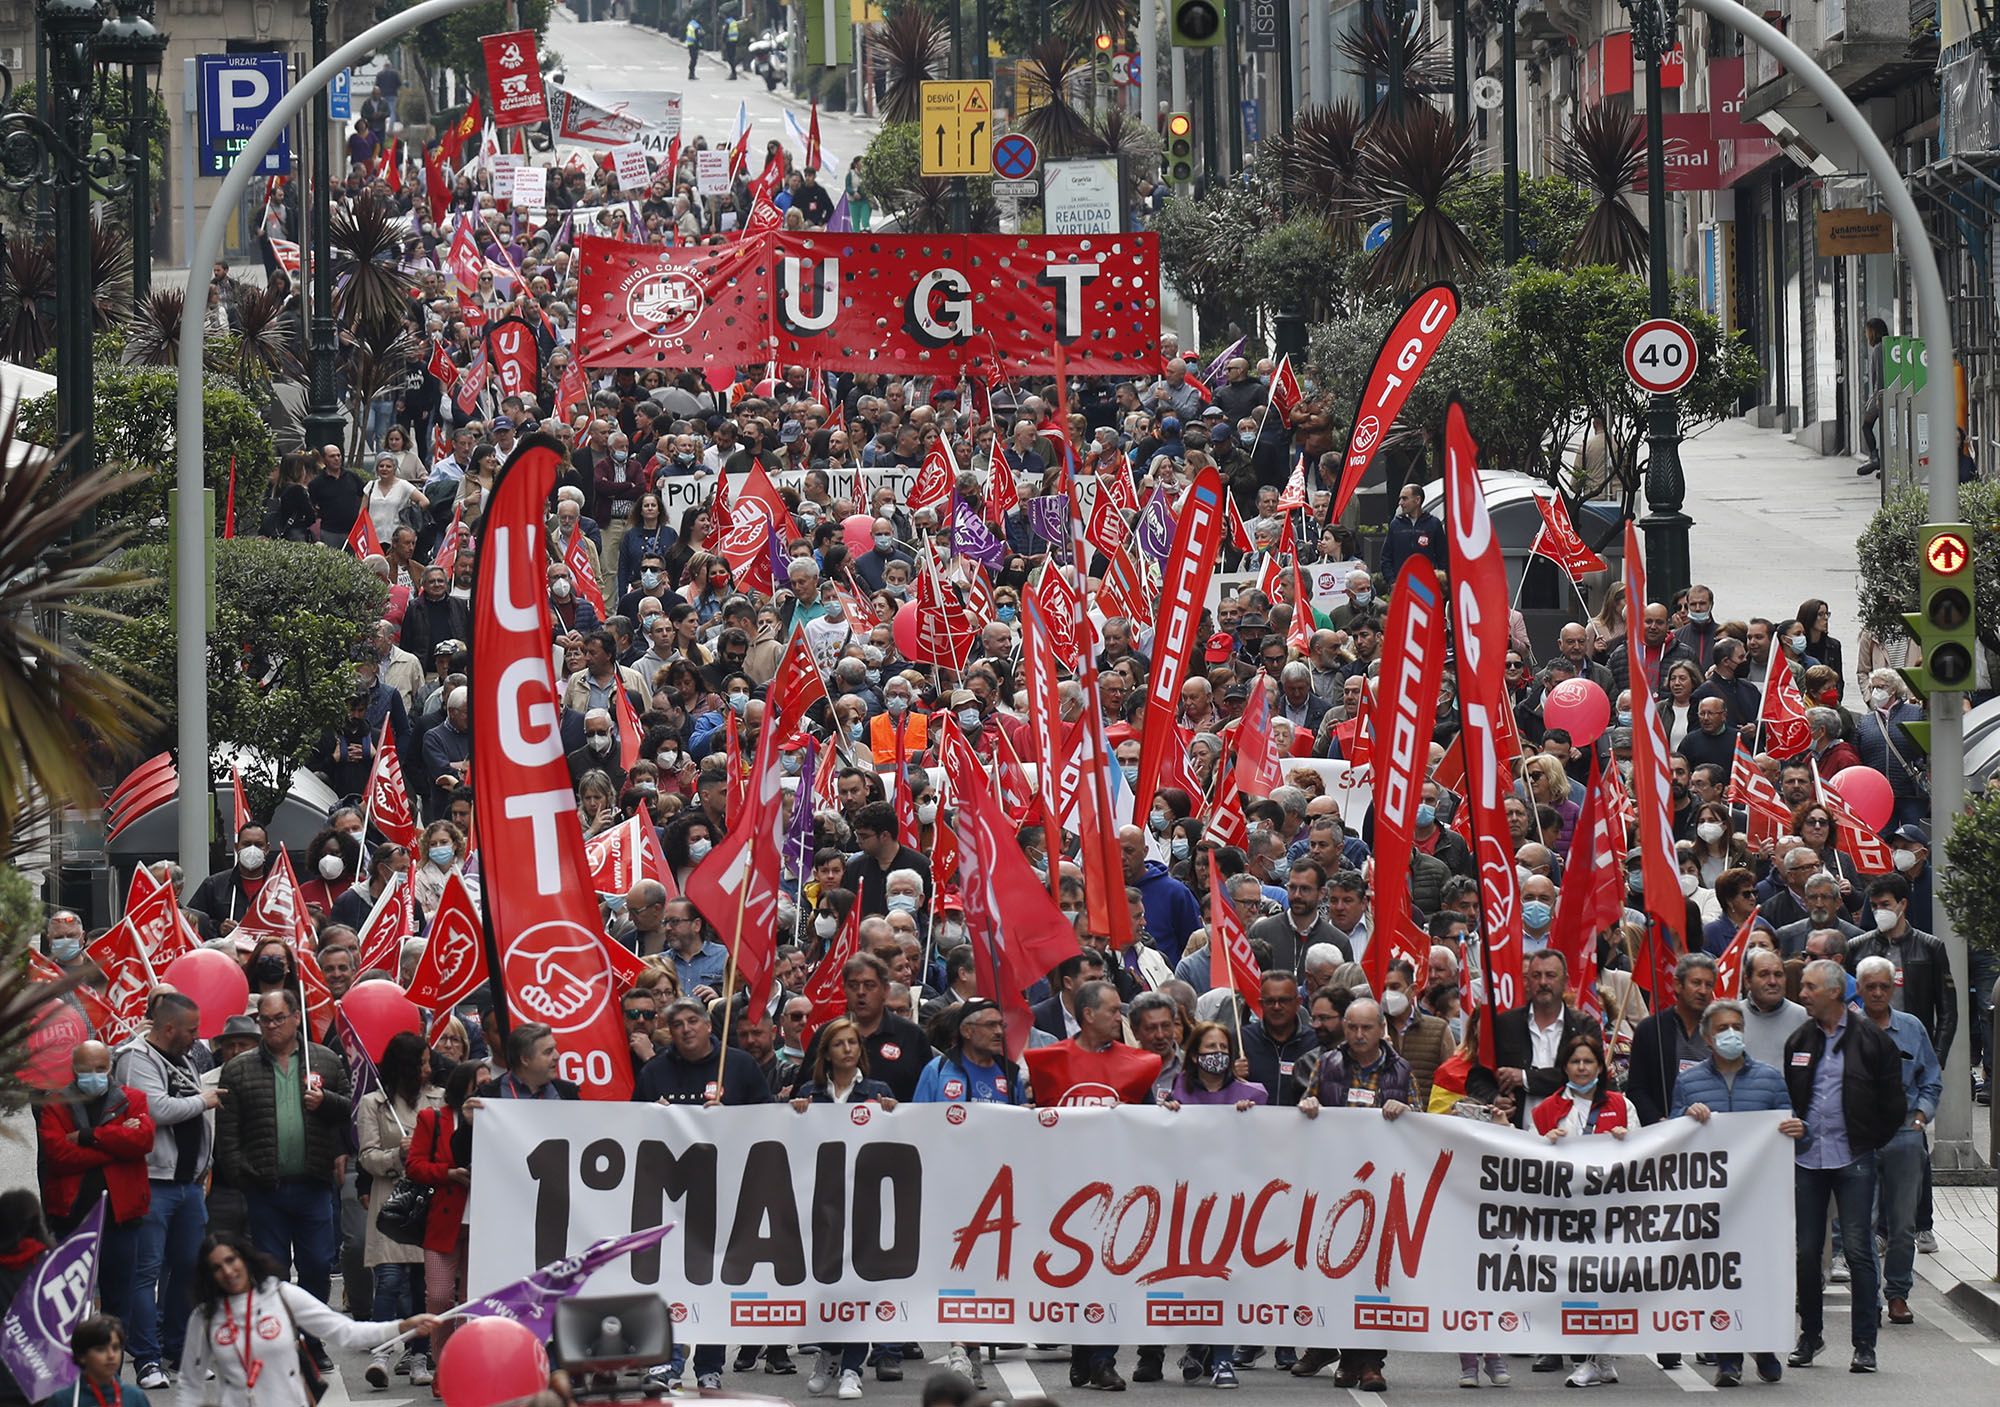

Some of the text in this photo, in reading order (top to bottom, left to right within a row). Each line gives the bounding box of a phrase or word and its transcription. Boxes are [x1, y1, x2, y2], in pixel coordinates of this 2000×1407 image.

[1257, 0, 1275, 47] LISB
[228, 57, 258, 66] URZAIZ
[218, 69, 270, 132] P
[927, 92, 955, 103] DESVÍO
[1055, 208, 1112, 223] REALIDAD
[1056, 220, 1111, 234] VIRTUAL!
[620, 264, 713, 293] UNION COMARCAL
[643, 281, 687, 302] UGT
[648, 337, 684, 349] VIGO
[1377, 299, 1450, 408] UGT
[1638, 343, 1683, 368] 40
[1349, 454, 1366, 467] VIGO
[1558, 683, 1584, 697] UGT
[493, 524, 577, 895] UGT
[1480, 1150, 1728, 1198] SUBIR SALARIOS
[952, 1164, 1021, 1283] A
[1032, 1149, 1453, 1293] SOLUCIÓN
[1478, 1202, 1721, 1244] CONTER PREZOS
[1477, 1246, 1742, 1294] MÁIS IGUALDADE
[734, 1300, 1707, 1334] CCOO UGT CCOO UGT CCOO UGT CCOO UGT CCOO UGT
